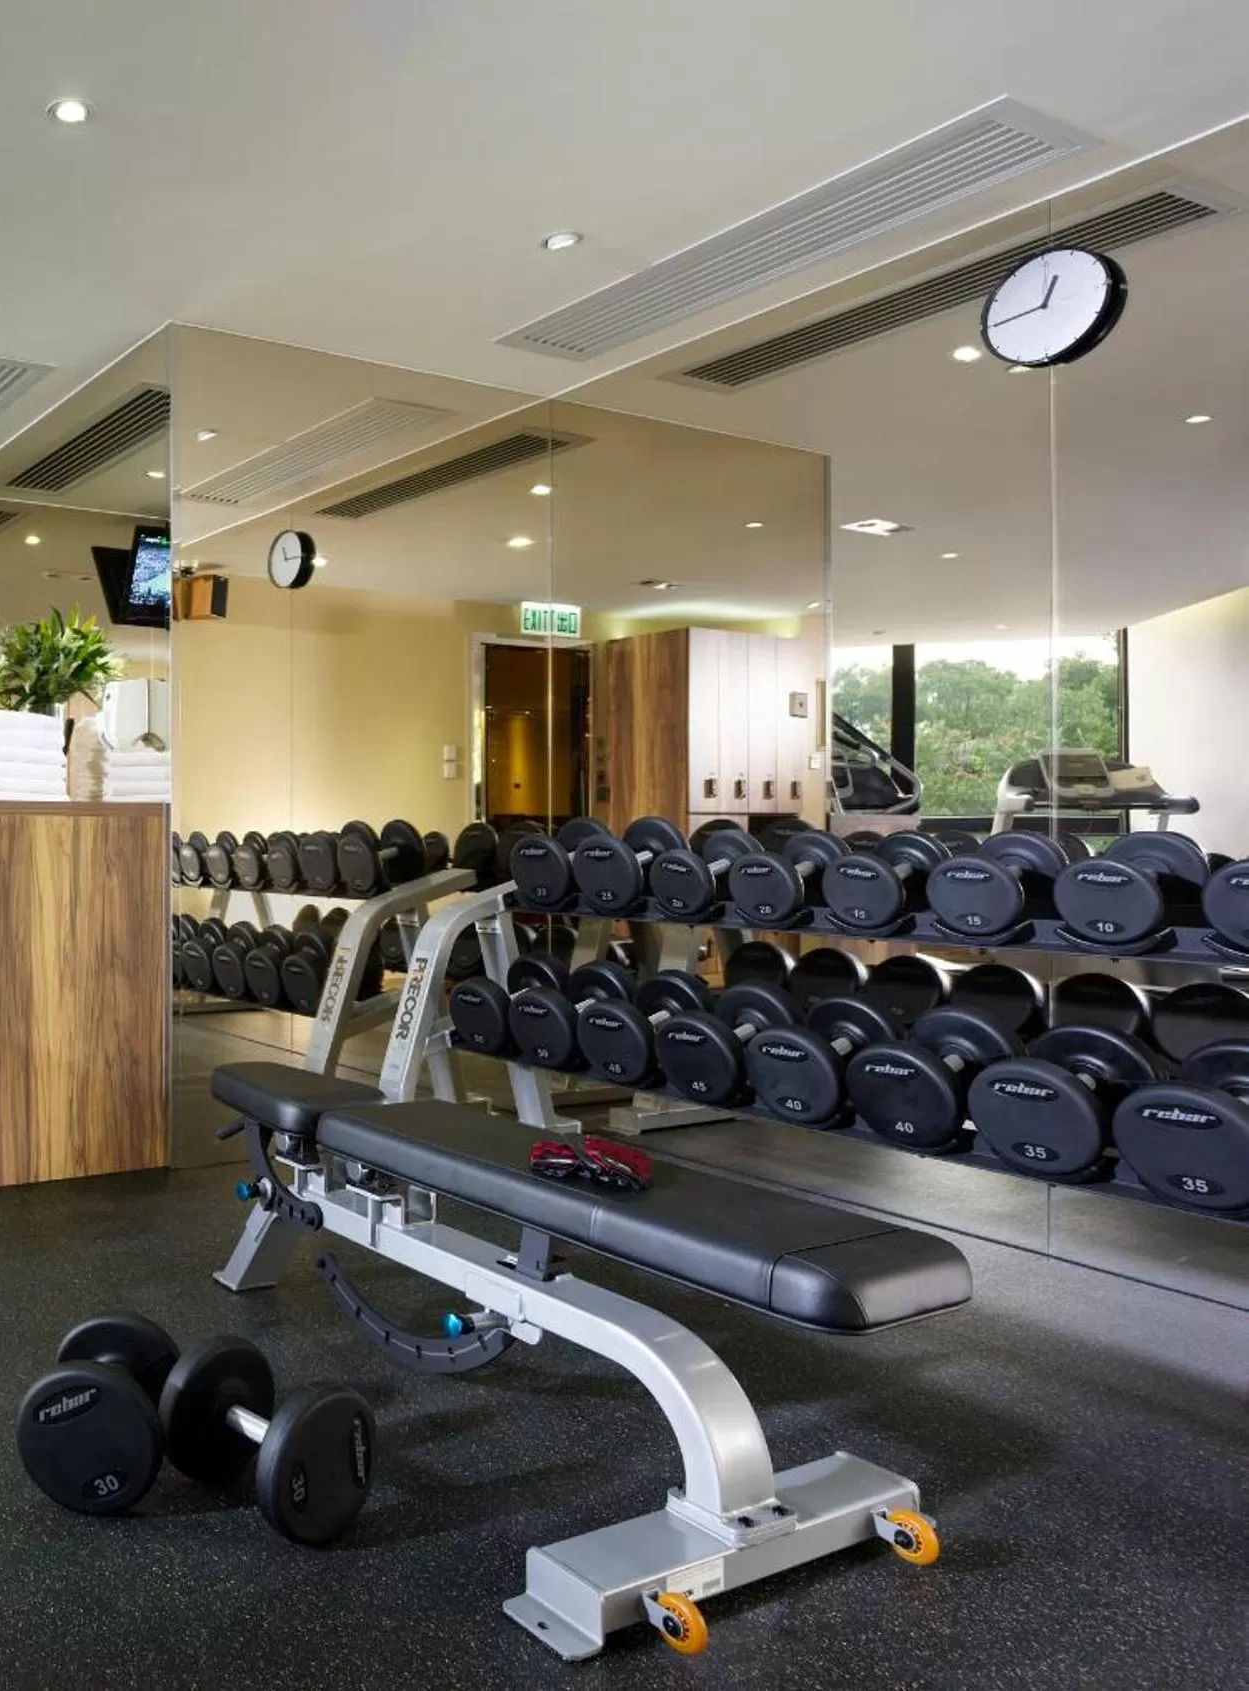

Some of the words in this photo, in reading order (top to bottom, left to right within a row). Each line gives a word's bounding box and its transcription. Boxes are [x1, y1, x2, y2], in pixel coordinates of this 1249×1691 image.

[965, 915, 982, 927] 15
[1097, 921, 1114, 934] 10
[395, 957, 429, 1041] PRECOR
[691, 1080, 708, 1092] 45
[785, 1099, 803, 1111] 40
[894, 1120, 915, 1134] 40
[1023, 1144, 1047, 1160] 35
[1181, 1176, 1209, 1194] 35
[93, 1473, 120, 1496] 30
